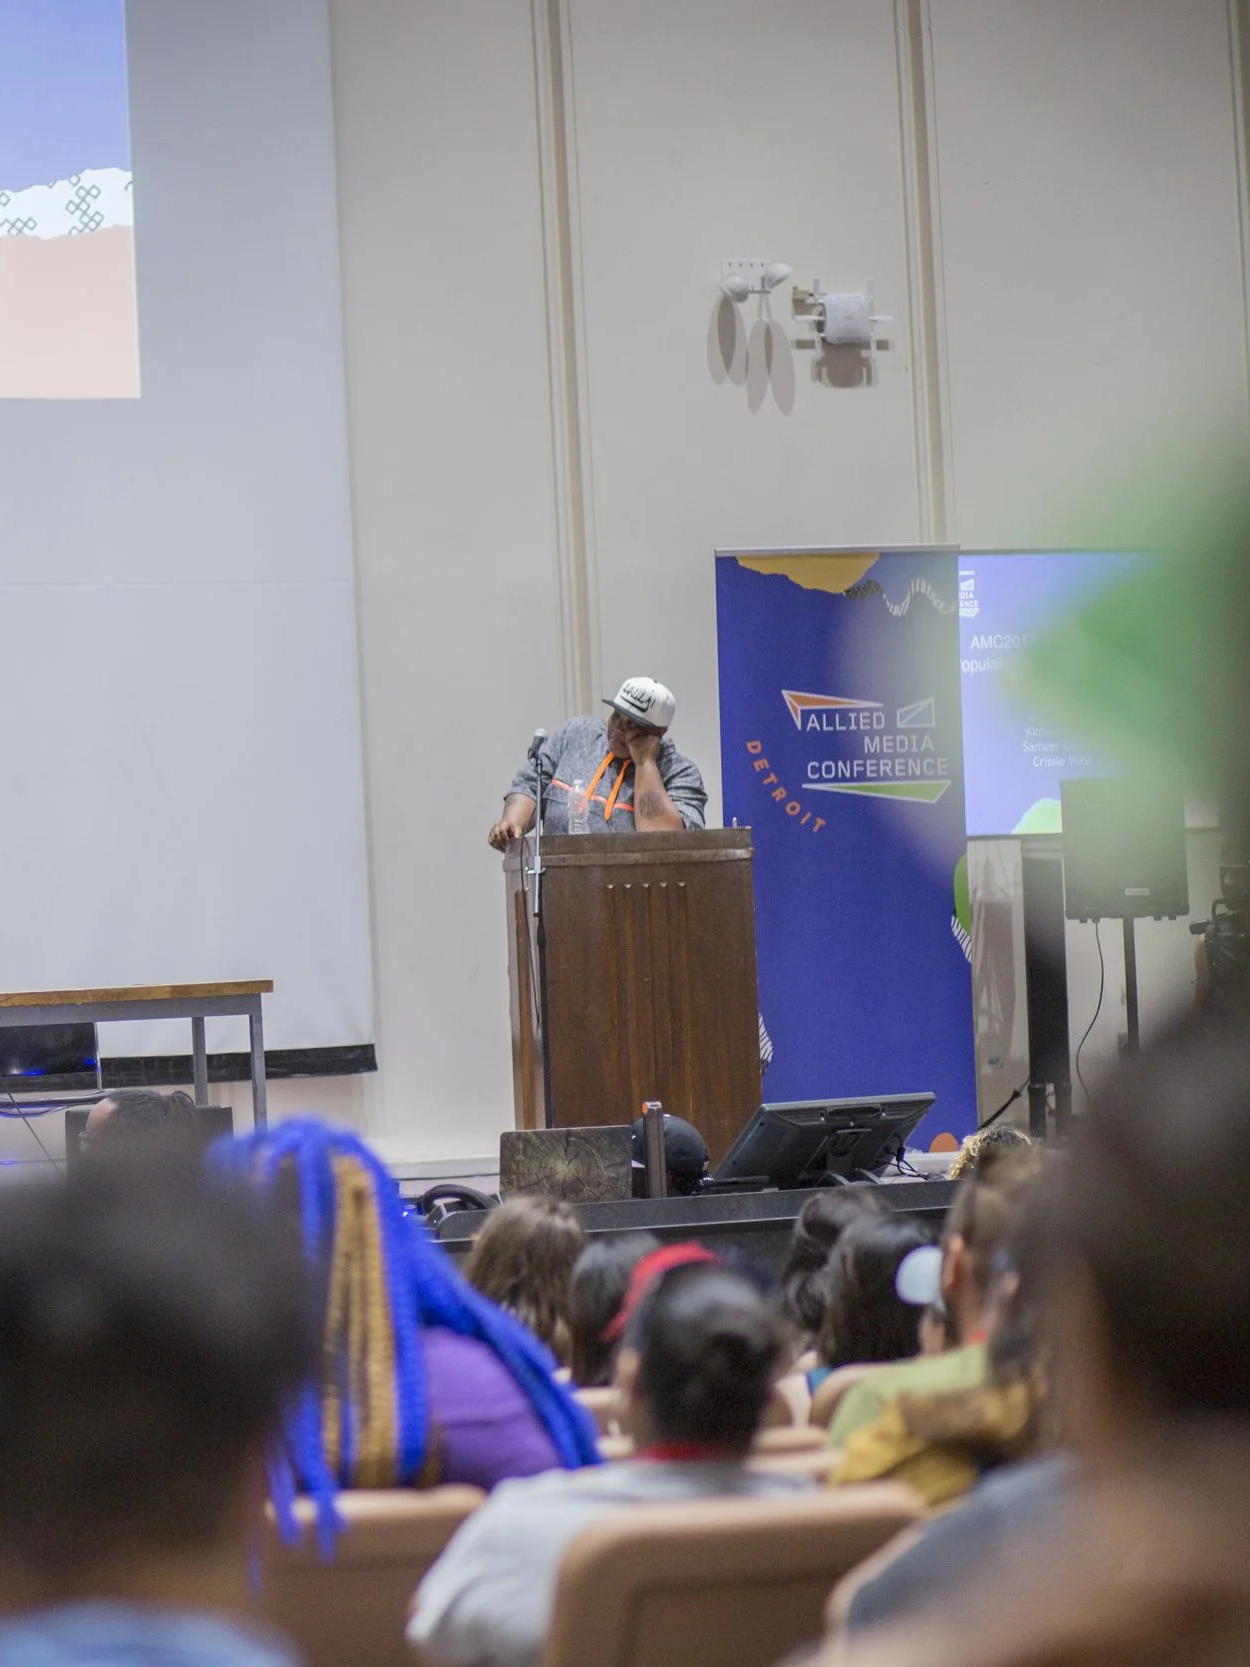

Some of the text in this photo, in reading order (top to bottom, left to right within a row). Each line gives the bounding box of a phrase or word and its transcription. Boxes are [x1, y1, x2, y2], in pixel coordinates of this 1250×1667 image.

[960, 656, 1002, 675] opular
[806, 711, 885, 732] ALLIED
[864, 734, 934, 753] MEDIA
[807, 757, 948, 779] CONFERENCE
[746, 740, 827, 833] DETROIT
